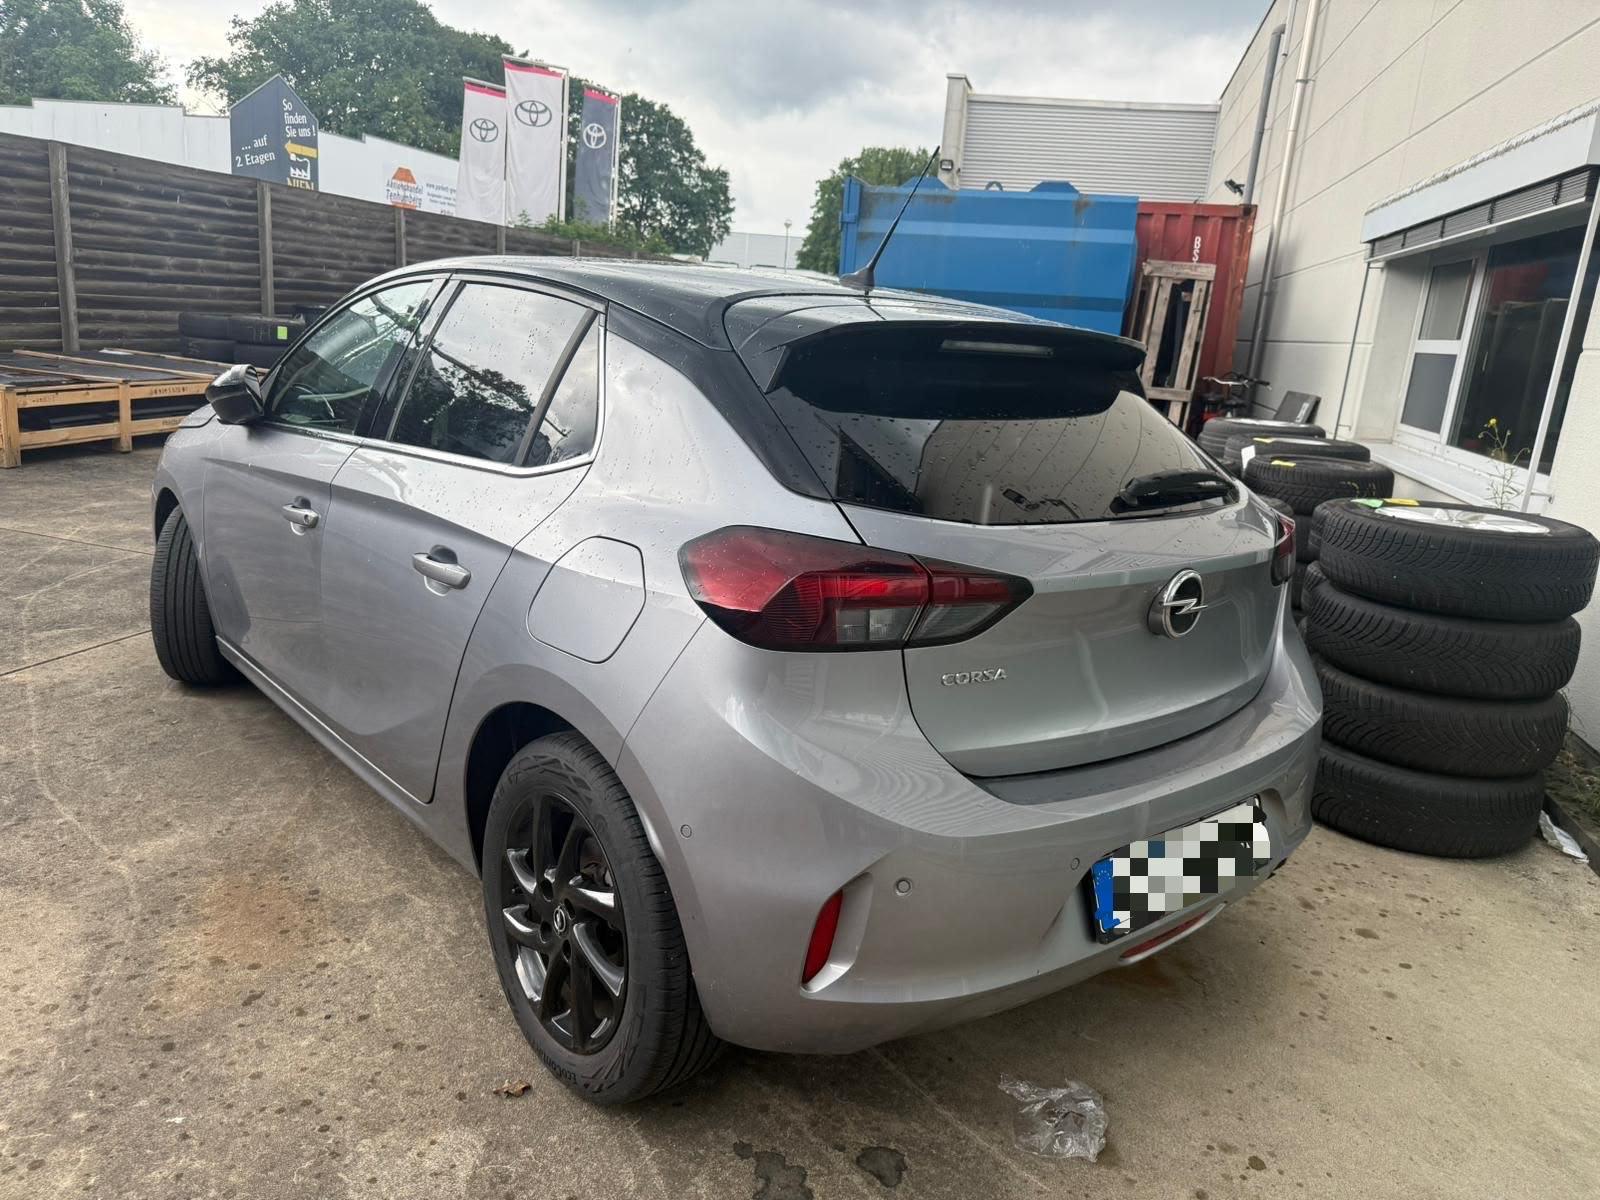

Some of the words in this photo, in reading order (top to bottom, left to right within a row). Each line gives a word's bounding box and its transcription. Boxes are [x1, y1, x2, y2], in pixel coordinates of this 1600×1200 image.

[282, 98, 293, 111] So
[284, 113, 307, 125] finden
[285, 129, 297, 138] Sie
[253, 134, 268, 148] auf
[235, 155, 244, 168] 2
[245, 151, 276, 166] Etagen
[1192, 236, 1201, 264] BS
[941, 668, 1008, 686] CORSA
